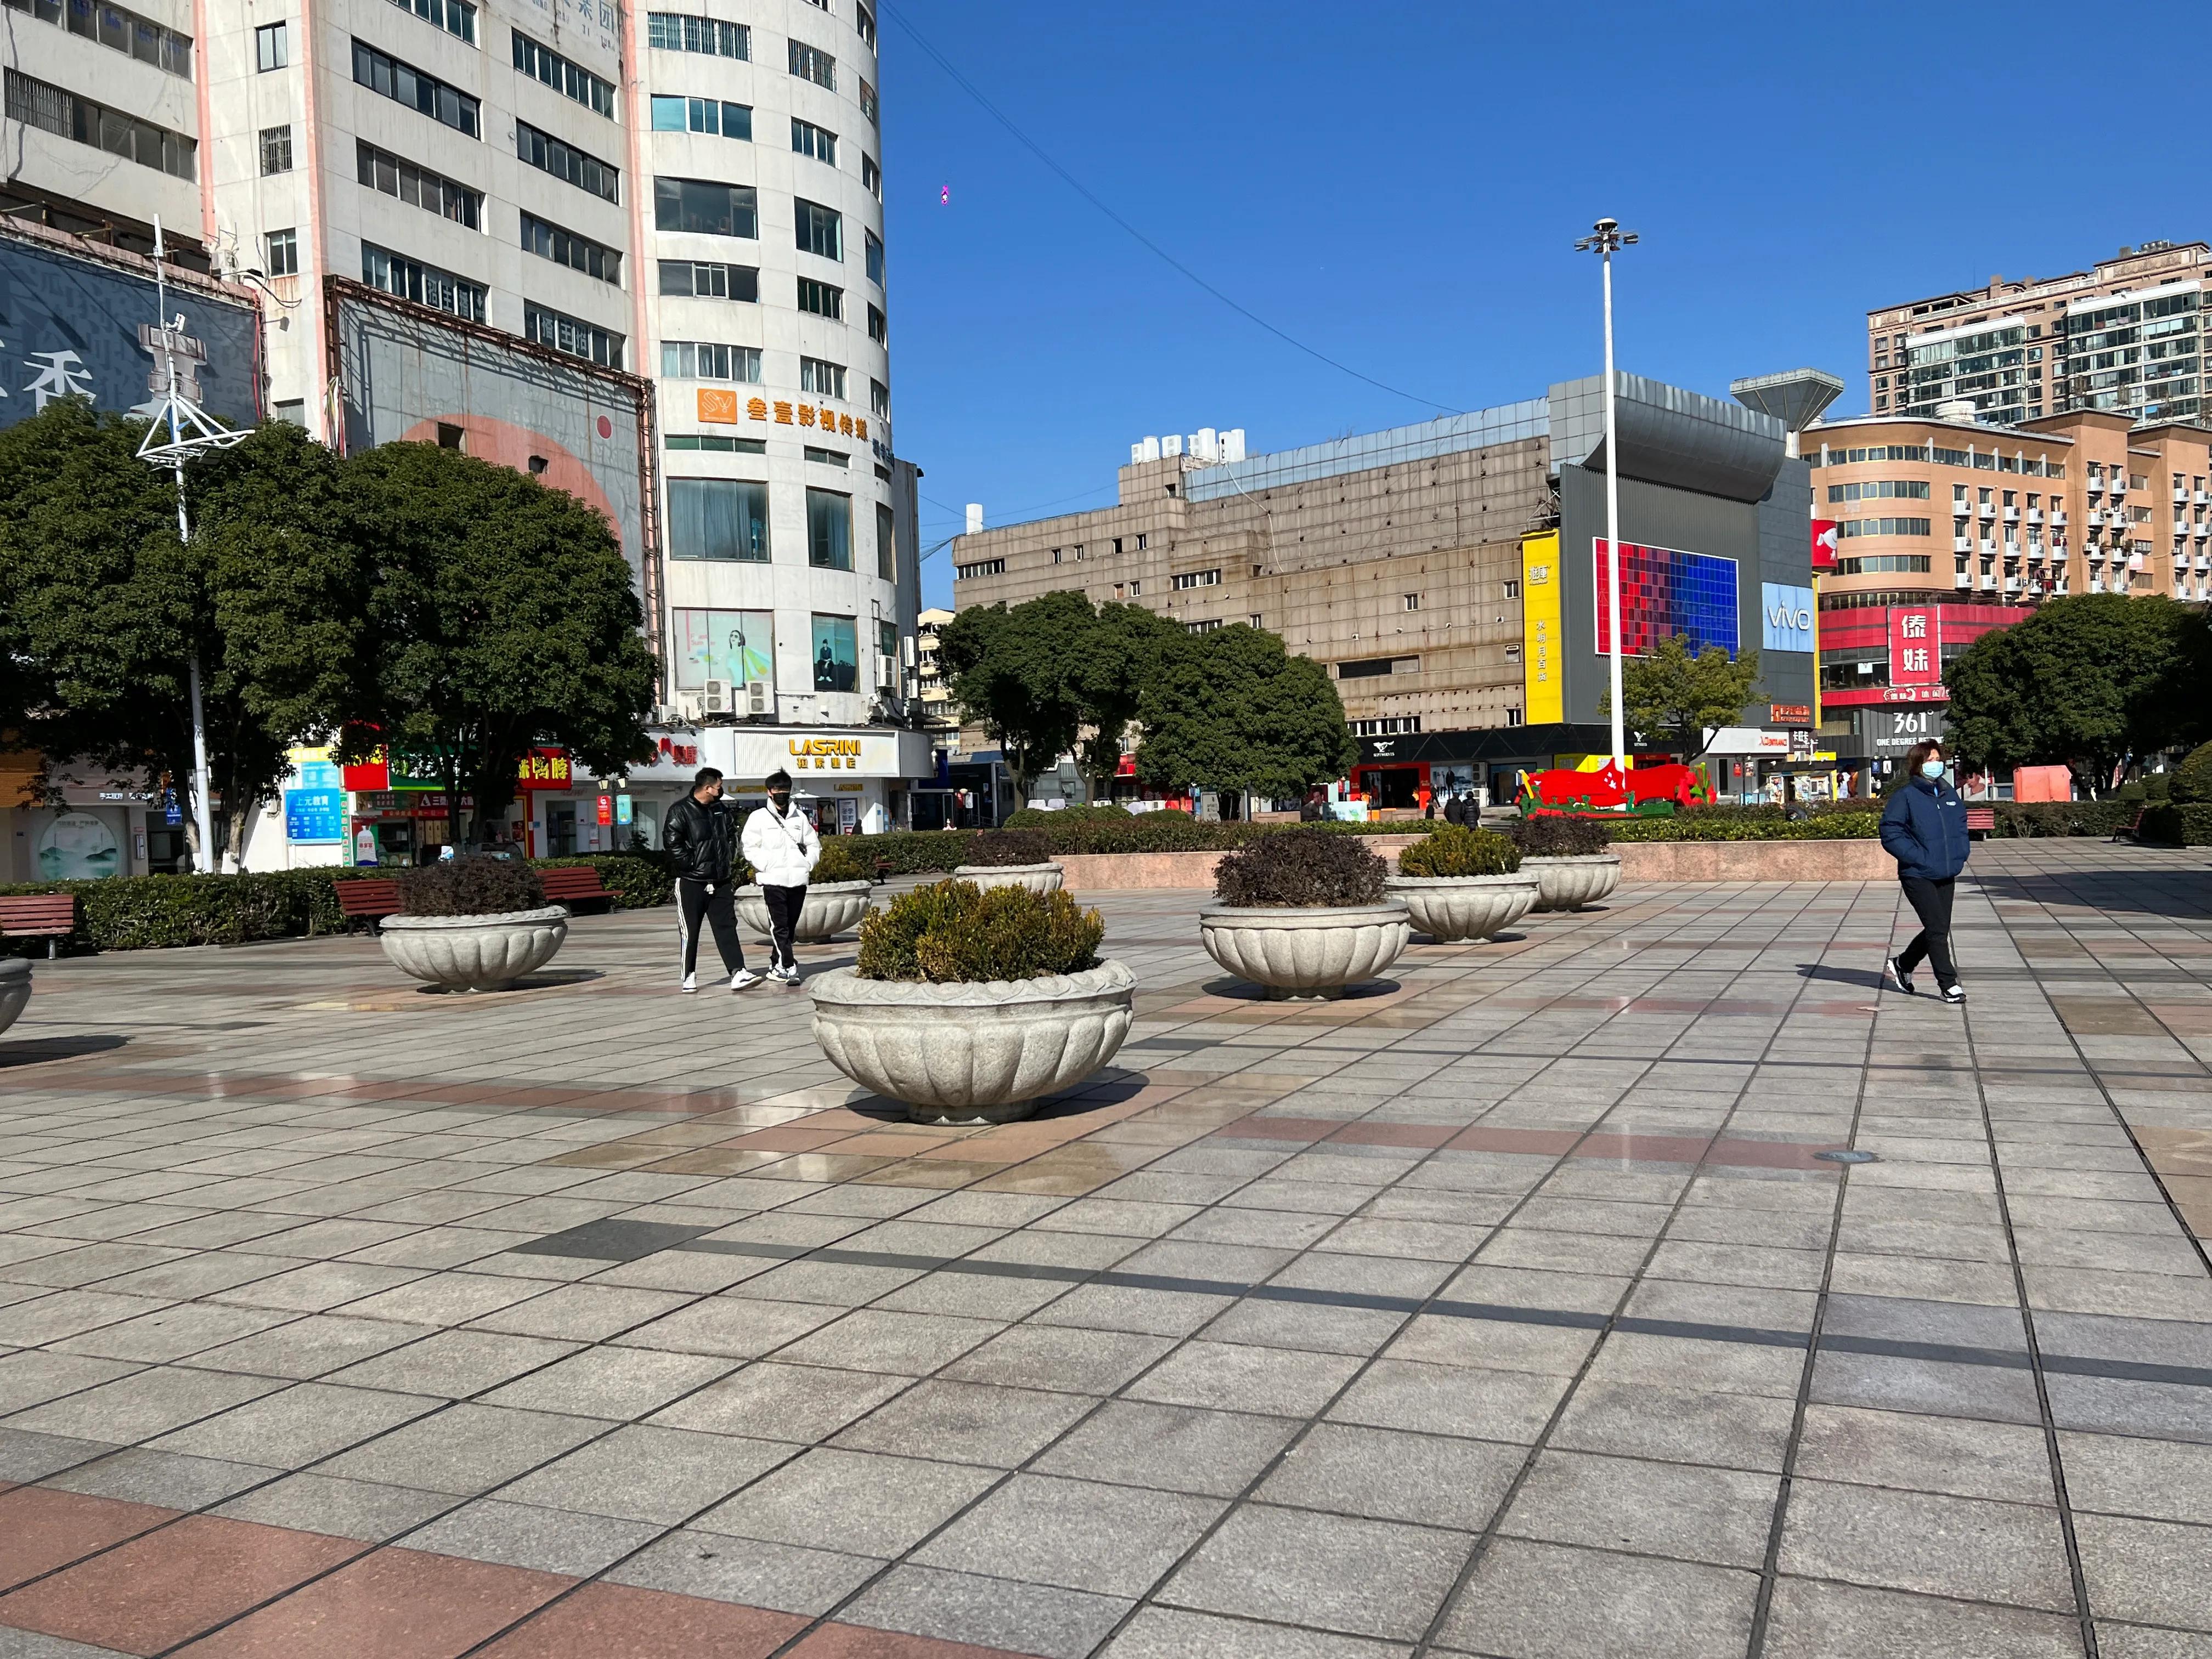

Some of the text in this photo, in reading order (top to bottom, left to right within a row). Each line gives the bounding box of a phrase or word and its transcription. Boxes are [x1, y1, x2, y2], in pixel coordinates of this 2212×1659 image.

[747, 397, 868, 442] 叁壹影视传媒
[1767, 600, 1810, 631] vivo
[1901, 614, 1929, 673] 傣妹
[788, 739, 861, 756] LASRINI
[1876, 738, 1889, 746] ONE
[1891, 737, 1917, 746] DEGREE
